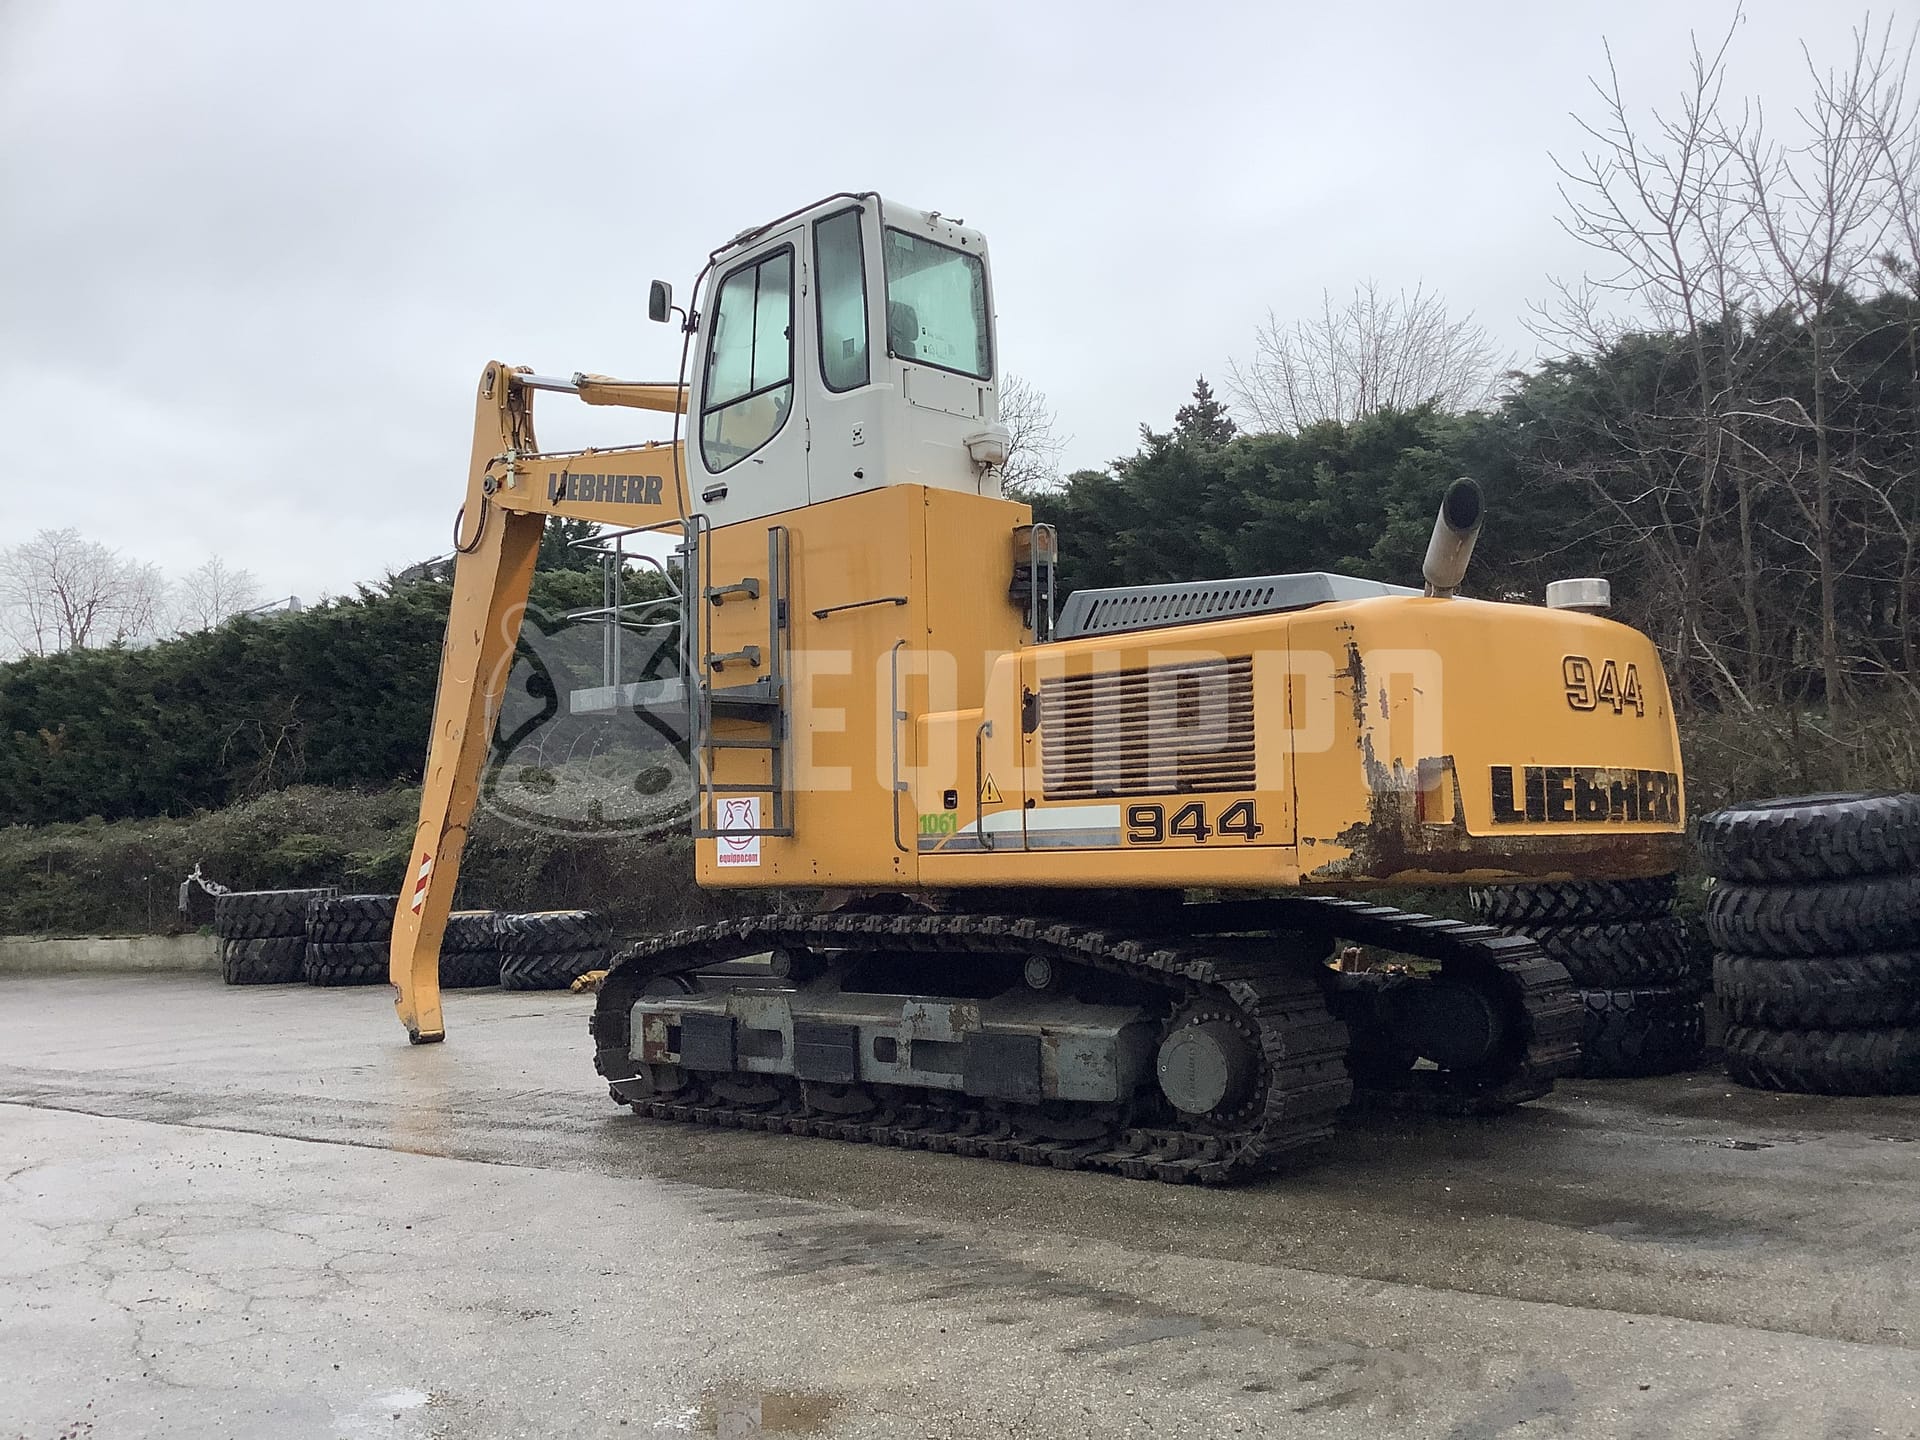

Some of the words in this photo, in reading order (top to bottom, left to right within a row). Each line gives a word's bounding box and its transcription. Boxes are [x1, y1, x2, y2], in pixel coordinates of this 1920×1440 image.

[547, 473, 662, 505] LIEBHERR
[1562, 655, 1644, 718] 944
[919, 812, 958, 834] 1061
[1126, 799, 1264, 845] 944
